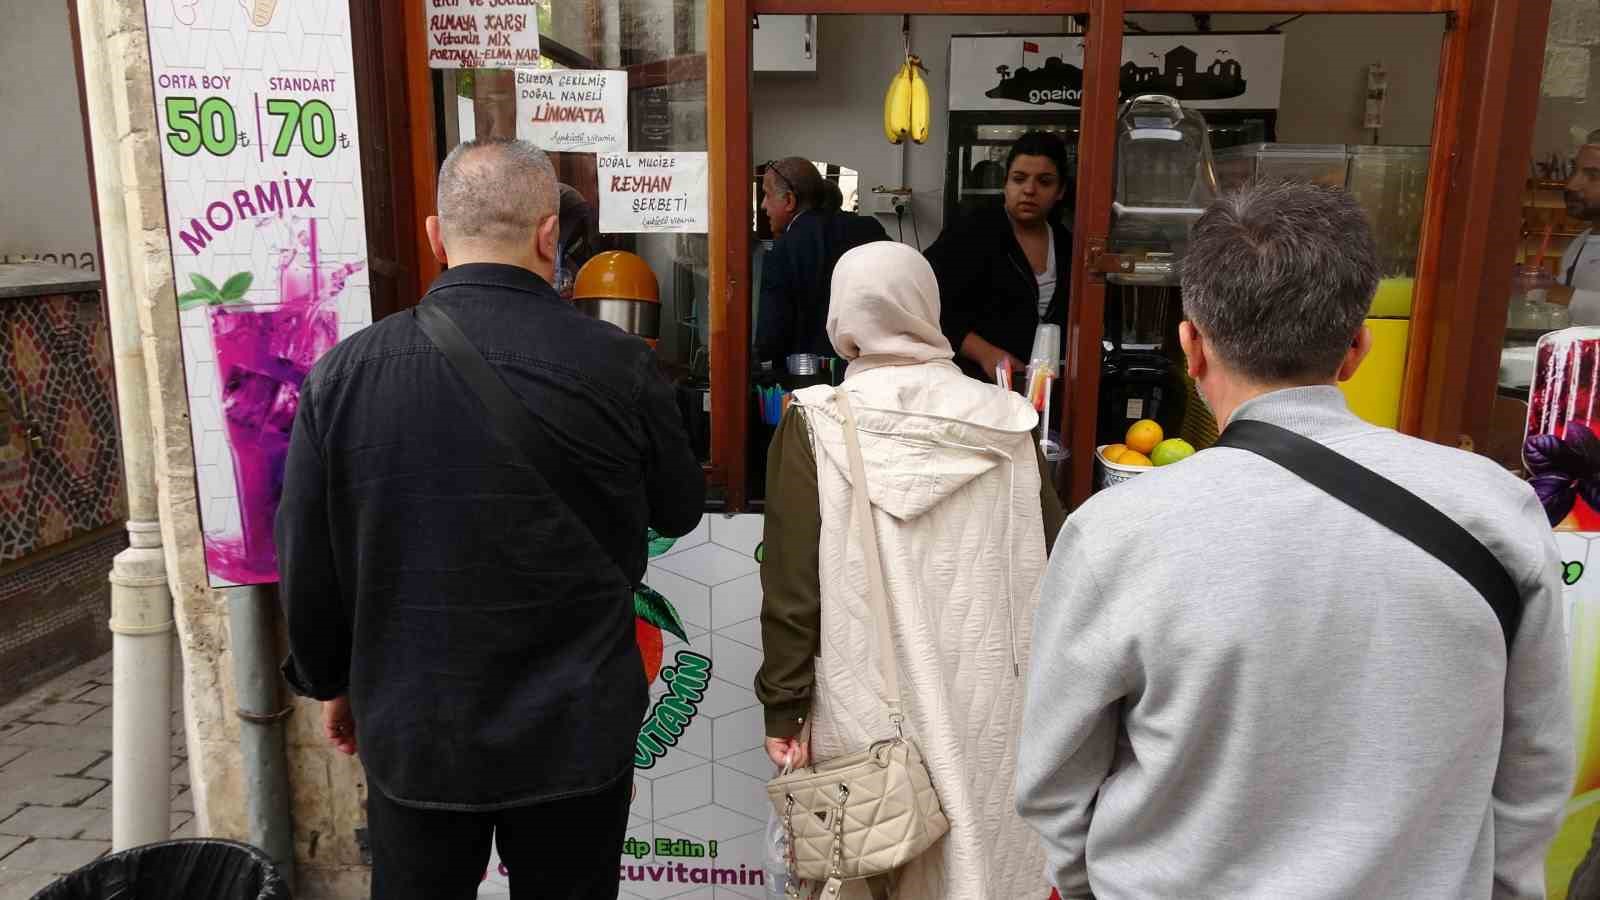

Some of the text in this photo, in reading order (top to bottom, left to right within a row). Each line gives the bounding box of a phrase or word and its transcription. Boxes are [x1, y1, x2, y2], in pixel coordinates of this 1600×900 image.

[484, 14, 527, 32] KARŞI
[158, 74, 231, 90] ORTA BOY
[269, 77, 336, 93] STANDART
[516, 72, 554, 86] BUZDA
[521, 88, 556, 101] DOĞAL
[531, 102, 605, 123] LİMONATA
[599, 154, 632, 169] DOĞAL
[610, 175, 673, 193] REYHAN
[632, 192, 688, 213] ŞERBETİ
[178, 170, 316, 257] MORMİX
[654, 838, 705, 857] Edin
